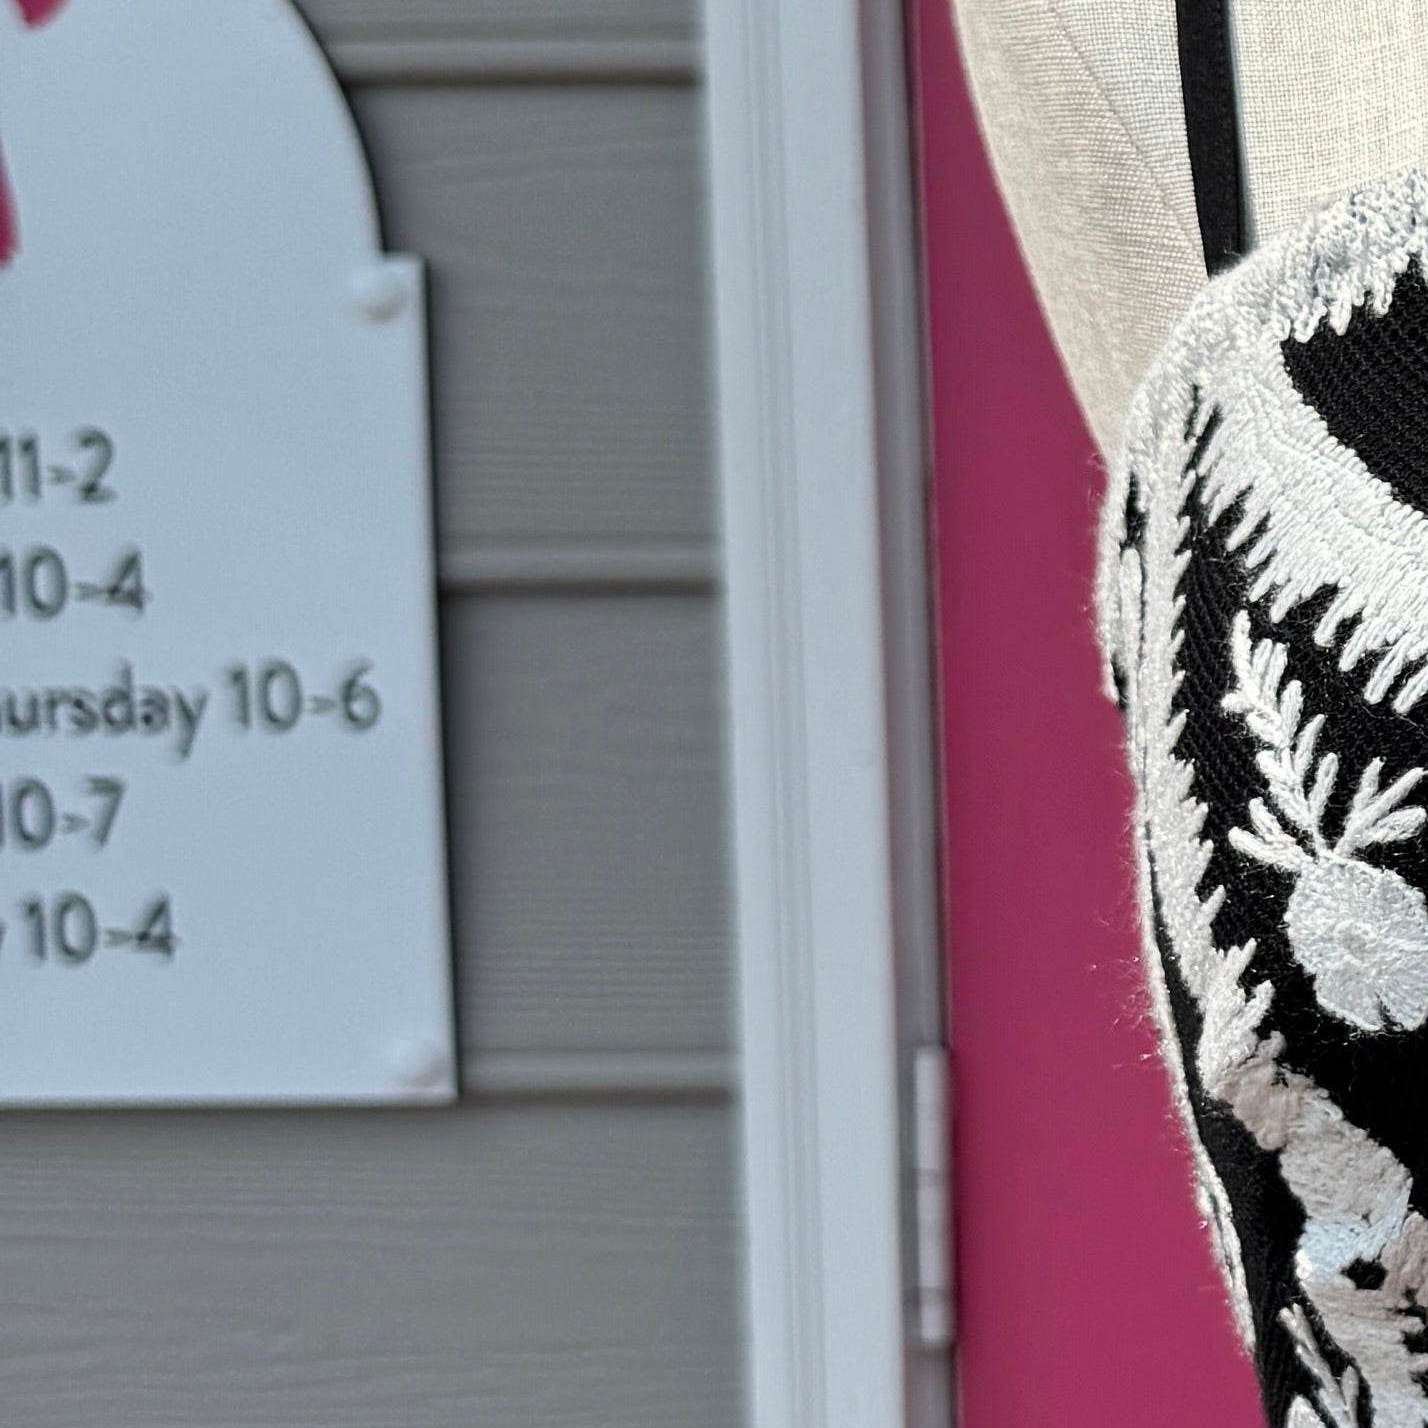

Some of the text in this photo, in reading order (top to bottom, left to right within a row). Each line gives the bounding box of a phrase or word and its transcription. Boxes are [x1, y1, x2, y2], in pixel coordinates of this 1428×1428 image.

[0, 546, 151, 618] 10-4
[0, 658, 381, 760] ursday 10-6
[0, 776, 126, 851] 0-7
[23, 892, 180, 964] 10-4
